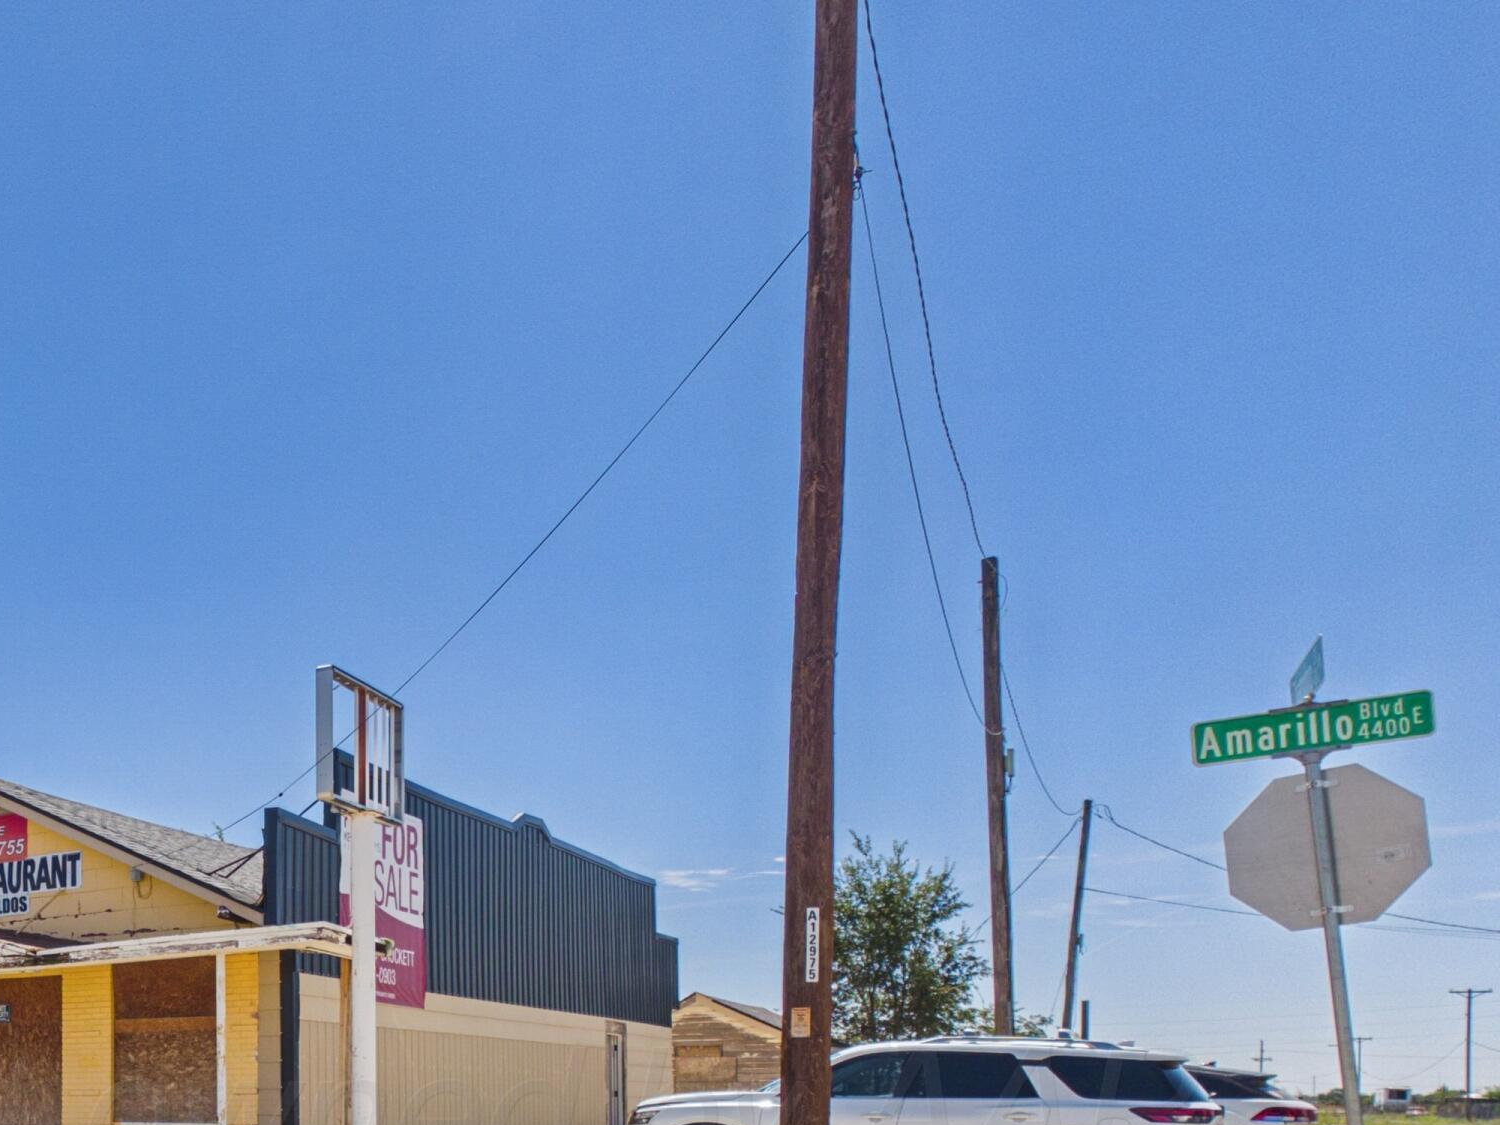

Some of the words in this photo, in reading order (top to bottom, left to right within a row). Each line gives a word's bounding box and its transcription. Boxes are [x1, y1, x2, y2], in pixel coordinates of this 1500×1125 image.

[1199, 710, 1353, 760] Amarillo
[1358, 717, 1410, 740] 4400
[1359, 698, 1404, 720] Blvd
[1412, 706, 1424, 724] E
[380, 823, 419, 870] FOR
[375, 859, 420, 916] SALE
[807, 910, 818, 980] A12975
